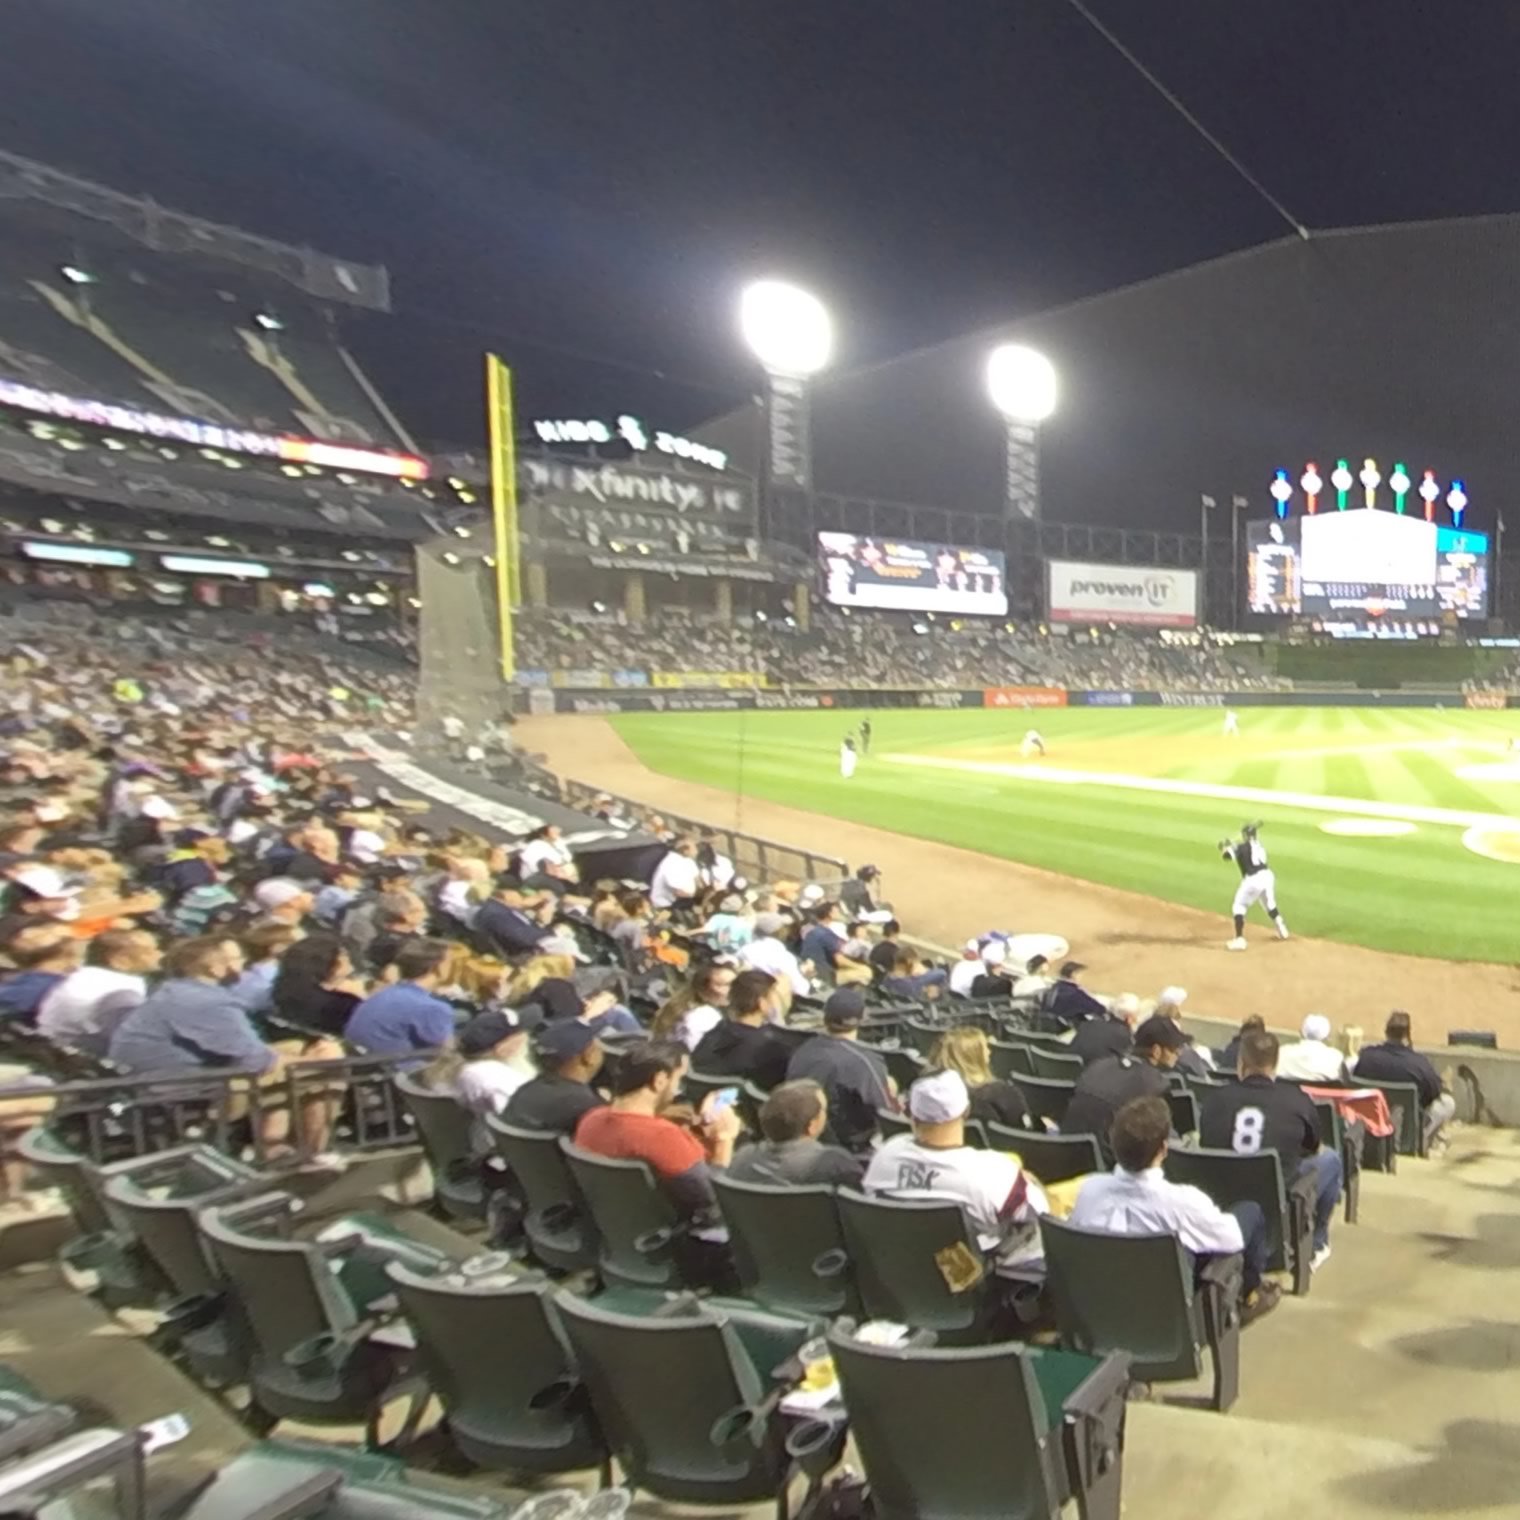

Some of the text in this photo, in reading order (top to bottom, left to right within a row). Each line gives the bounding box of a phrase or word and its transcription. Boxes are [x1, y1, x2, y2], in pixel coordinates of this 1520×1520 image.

[1069, 578, 1144, 598] proven
[1232, 1106, 1264, 1157] 8
[898, 1163, 941, 1191] FISK
